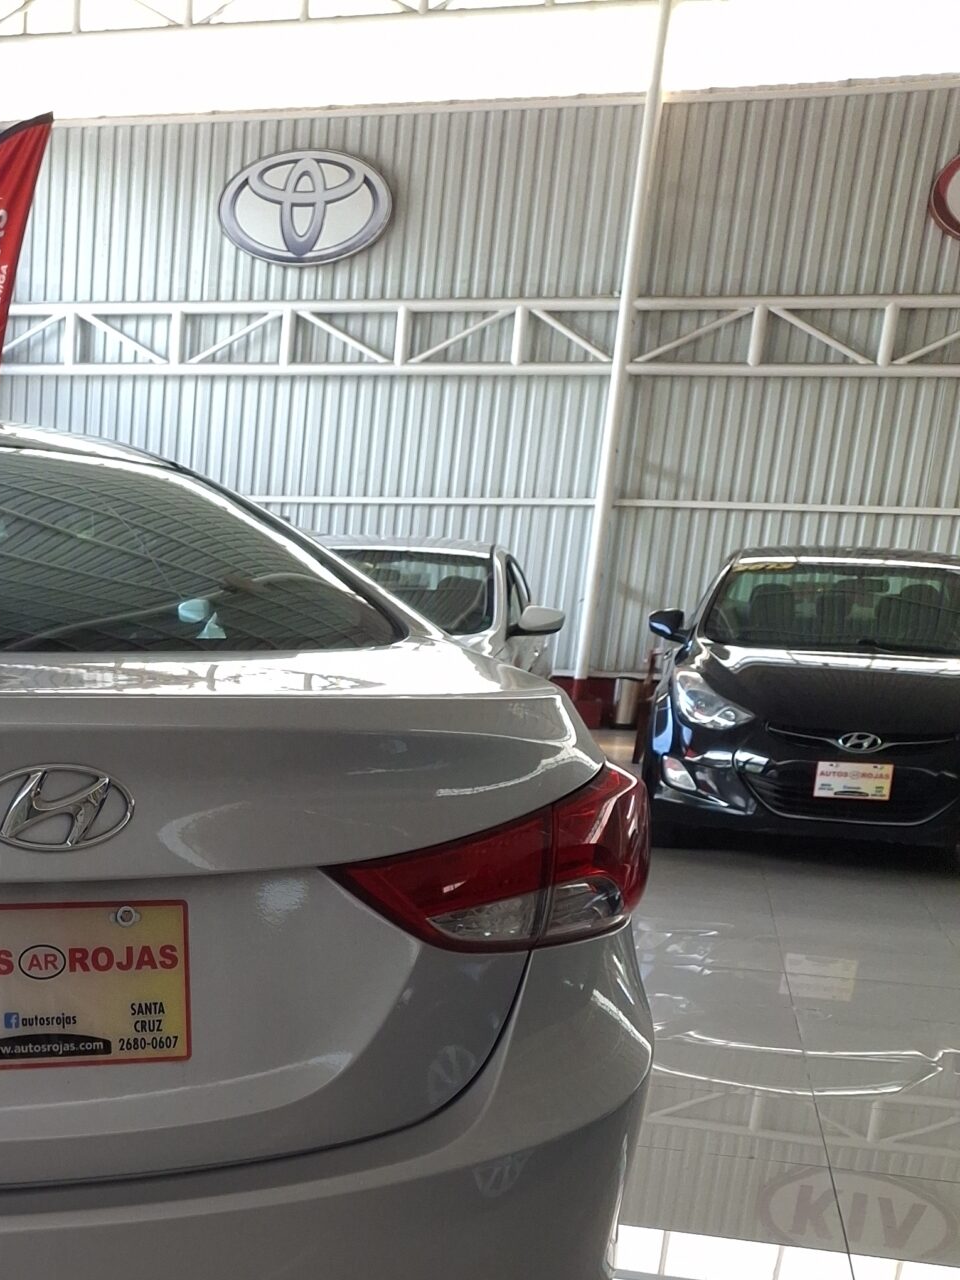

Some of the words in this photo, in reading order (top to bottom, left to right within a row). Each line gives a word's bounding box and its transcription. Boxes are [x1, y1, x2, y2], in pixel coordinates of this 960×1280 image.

[26, 953, 58, 972] AR
[68, 944, 179, 973] ROJAS
[130, 1001, 165, 1017] SANTA
[21, 1012, 77, 1030] autosrojas
[133, 1019, 163, 1033] CRUZ
[118, 1035, 179, 1051] 2680-0607
